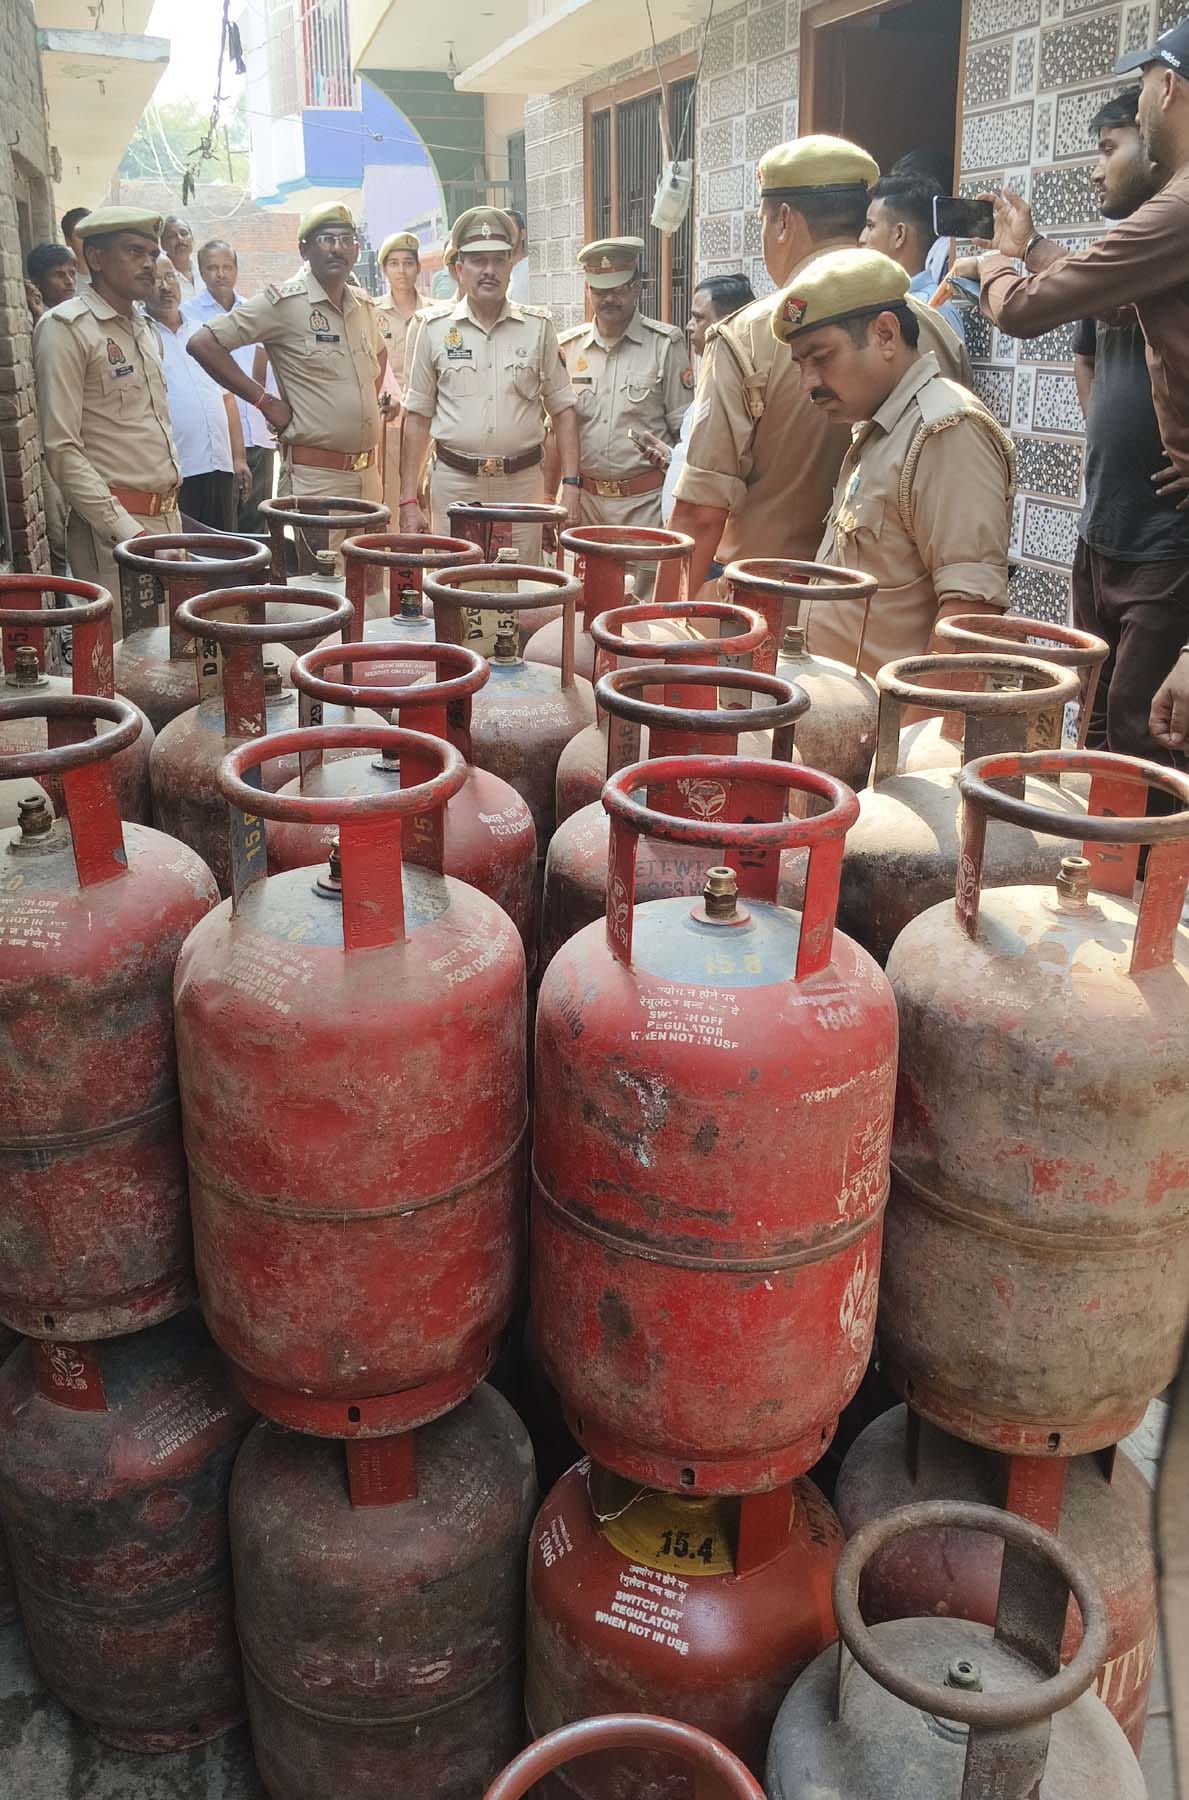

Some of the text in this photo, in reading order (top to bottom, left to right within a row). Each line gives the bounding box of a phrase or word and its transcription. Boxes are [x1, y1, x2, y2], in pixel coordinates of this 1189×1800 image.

[1161, 50, 1181, 67] adidas
[668, 1032, 695, 1044] NOT
[539, 1531, 556, 1567] 1906
[656, 1529, 713, 1565] 15.4
[611, 1601, 680, 1634] REGULATOR
[615, 1590, 685, 1620] SWITCH OFF
[595, 1610, 690, 1656] WHEN NOT IN USE
